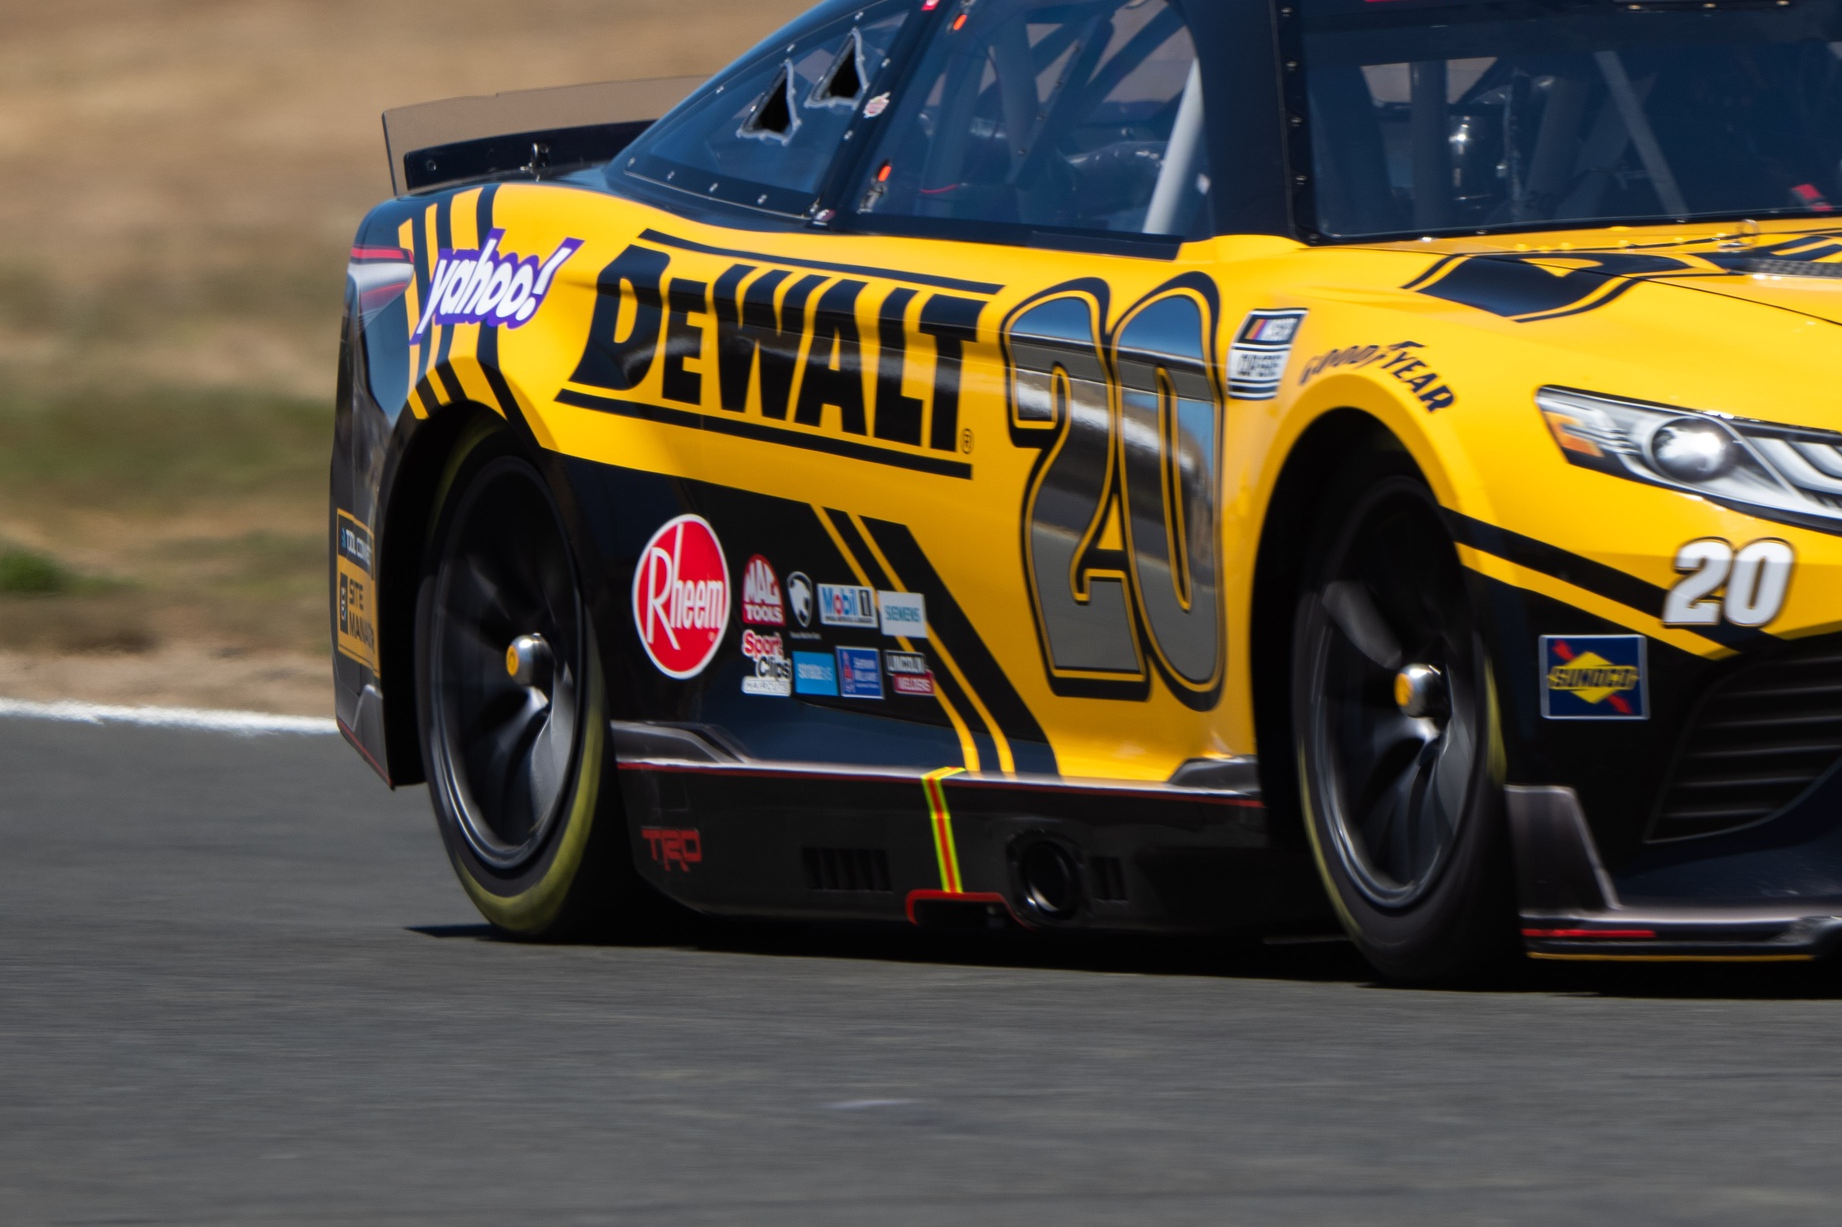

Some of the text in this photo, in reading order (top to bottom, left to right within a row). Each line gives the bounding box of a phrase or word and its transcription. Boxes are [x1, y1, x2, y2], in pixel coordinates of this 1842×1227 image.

[413, 235, 575, 336] yahoo!
[567, 243, 988, 453] DEWALT
[1000, 271, 1227, 712] 20
[646, 523, 724, 651] Rheem
[744, 604, 784, 623] TOOLS
[822, 587, 872, 617] Mobil 1
[1661, 536, 1797, 629] 20
[743, 631, 783, 660] Sport
[757, 656, 792, 681] Clips
[641, 828, 703, 872] TRD
